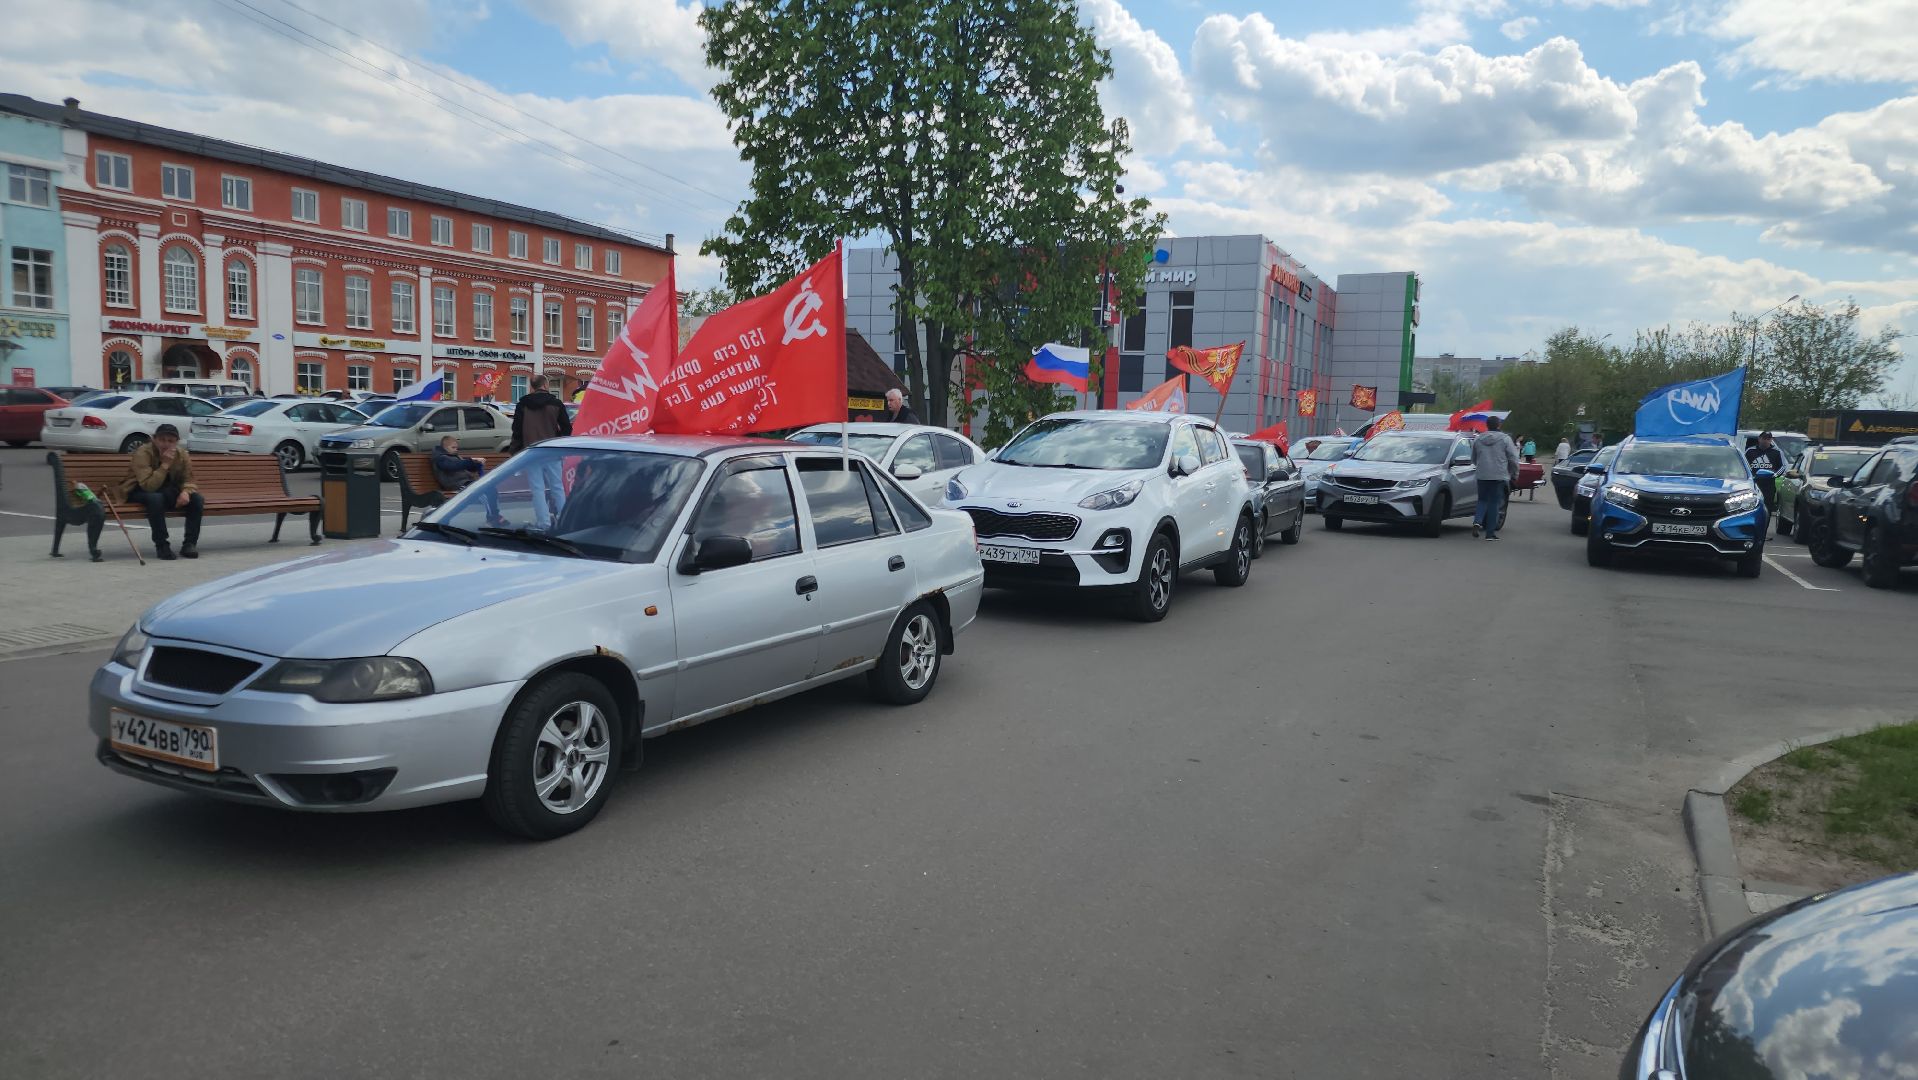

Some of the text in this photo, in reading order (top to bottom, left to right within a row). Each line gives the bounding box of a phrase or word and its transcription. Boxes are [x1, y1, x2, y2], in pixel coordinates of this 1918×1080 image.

[1160, 270, 1197, 286] мир
[109, 320, 191, 335] ЭКОНОМАРКЕТ
[116, 717, 209, 752] У424ВВ 790
